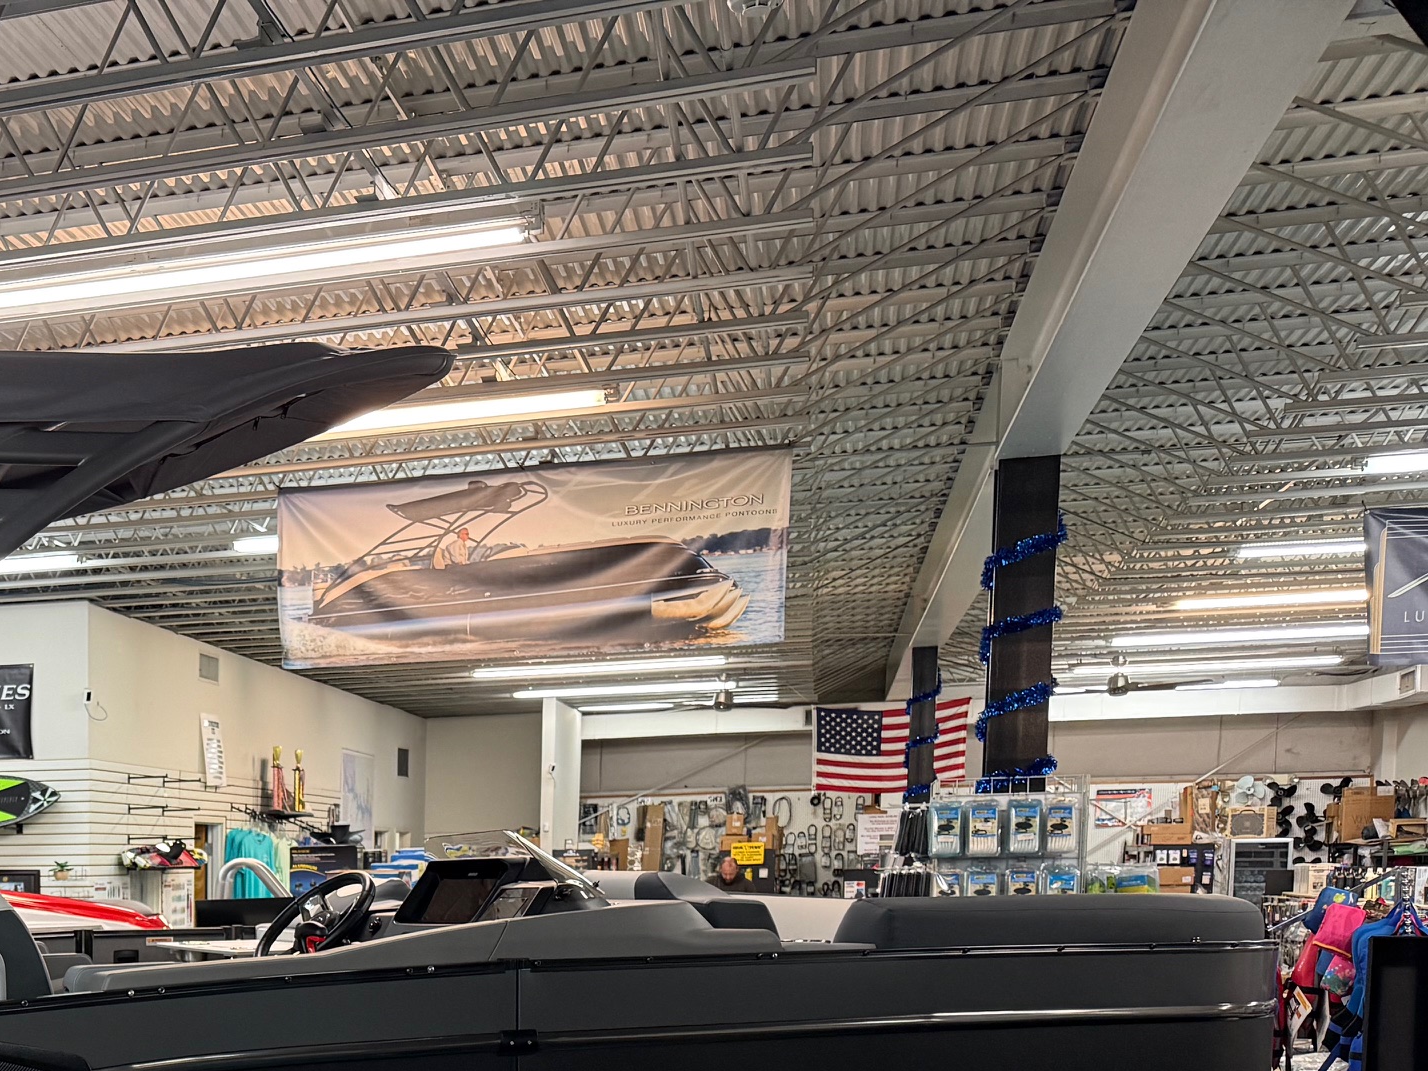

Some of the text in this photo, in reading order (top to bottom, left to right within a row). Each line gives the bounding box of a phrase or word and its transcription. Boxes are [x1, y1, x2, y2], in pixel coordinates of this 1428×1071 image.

[625, 493, 764, 517] BENNINGTON
[611, 508, 778, 527] LUXURY PERFORMANCE PONTOONS
